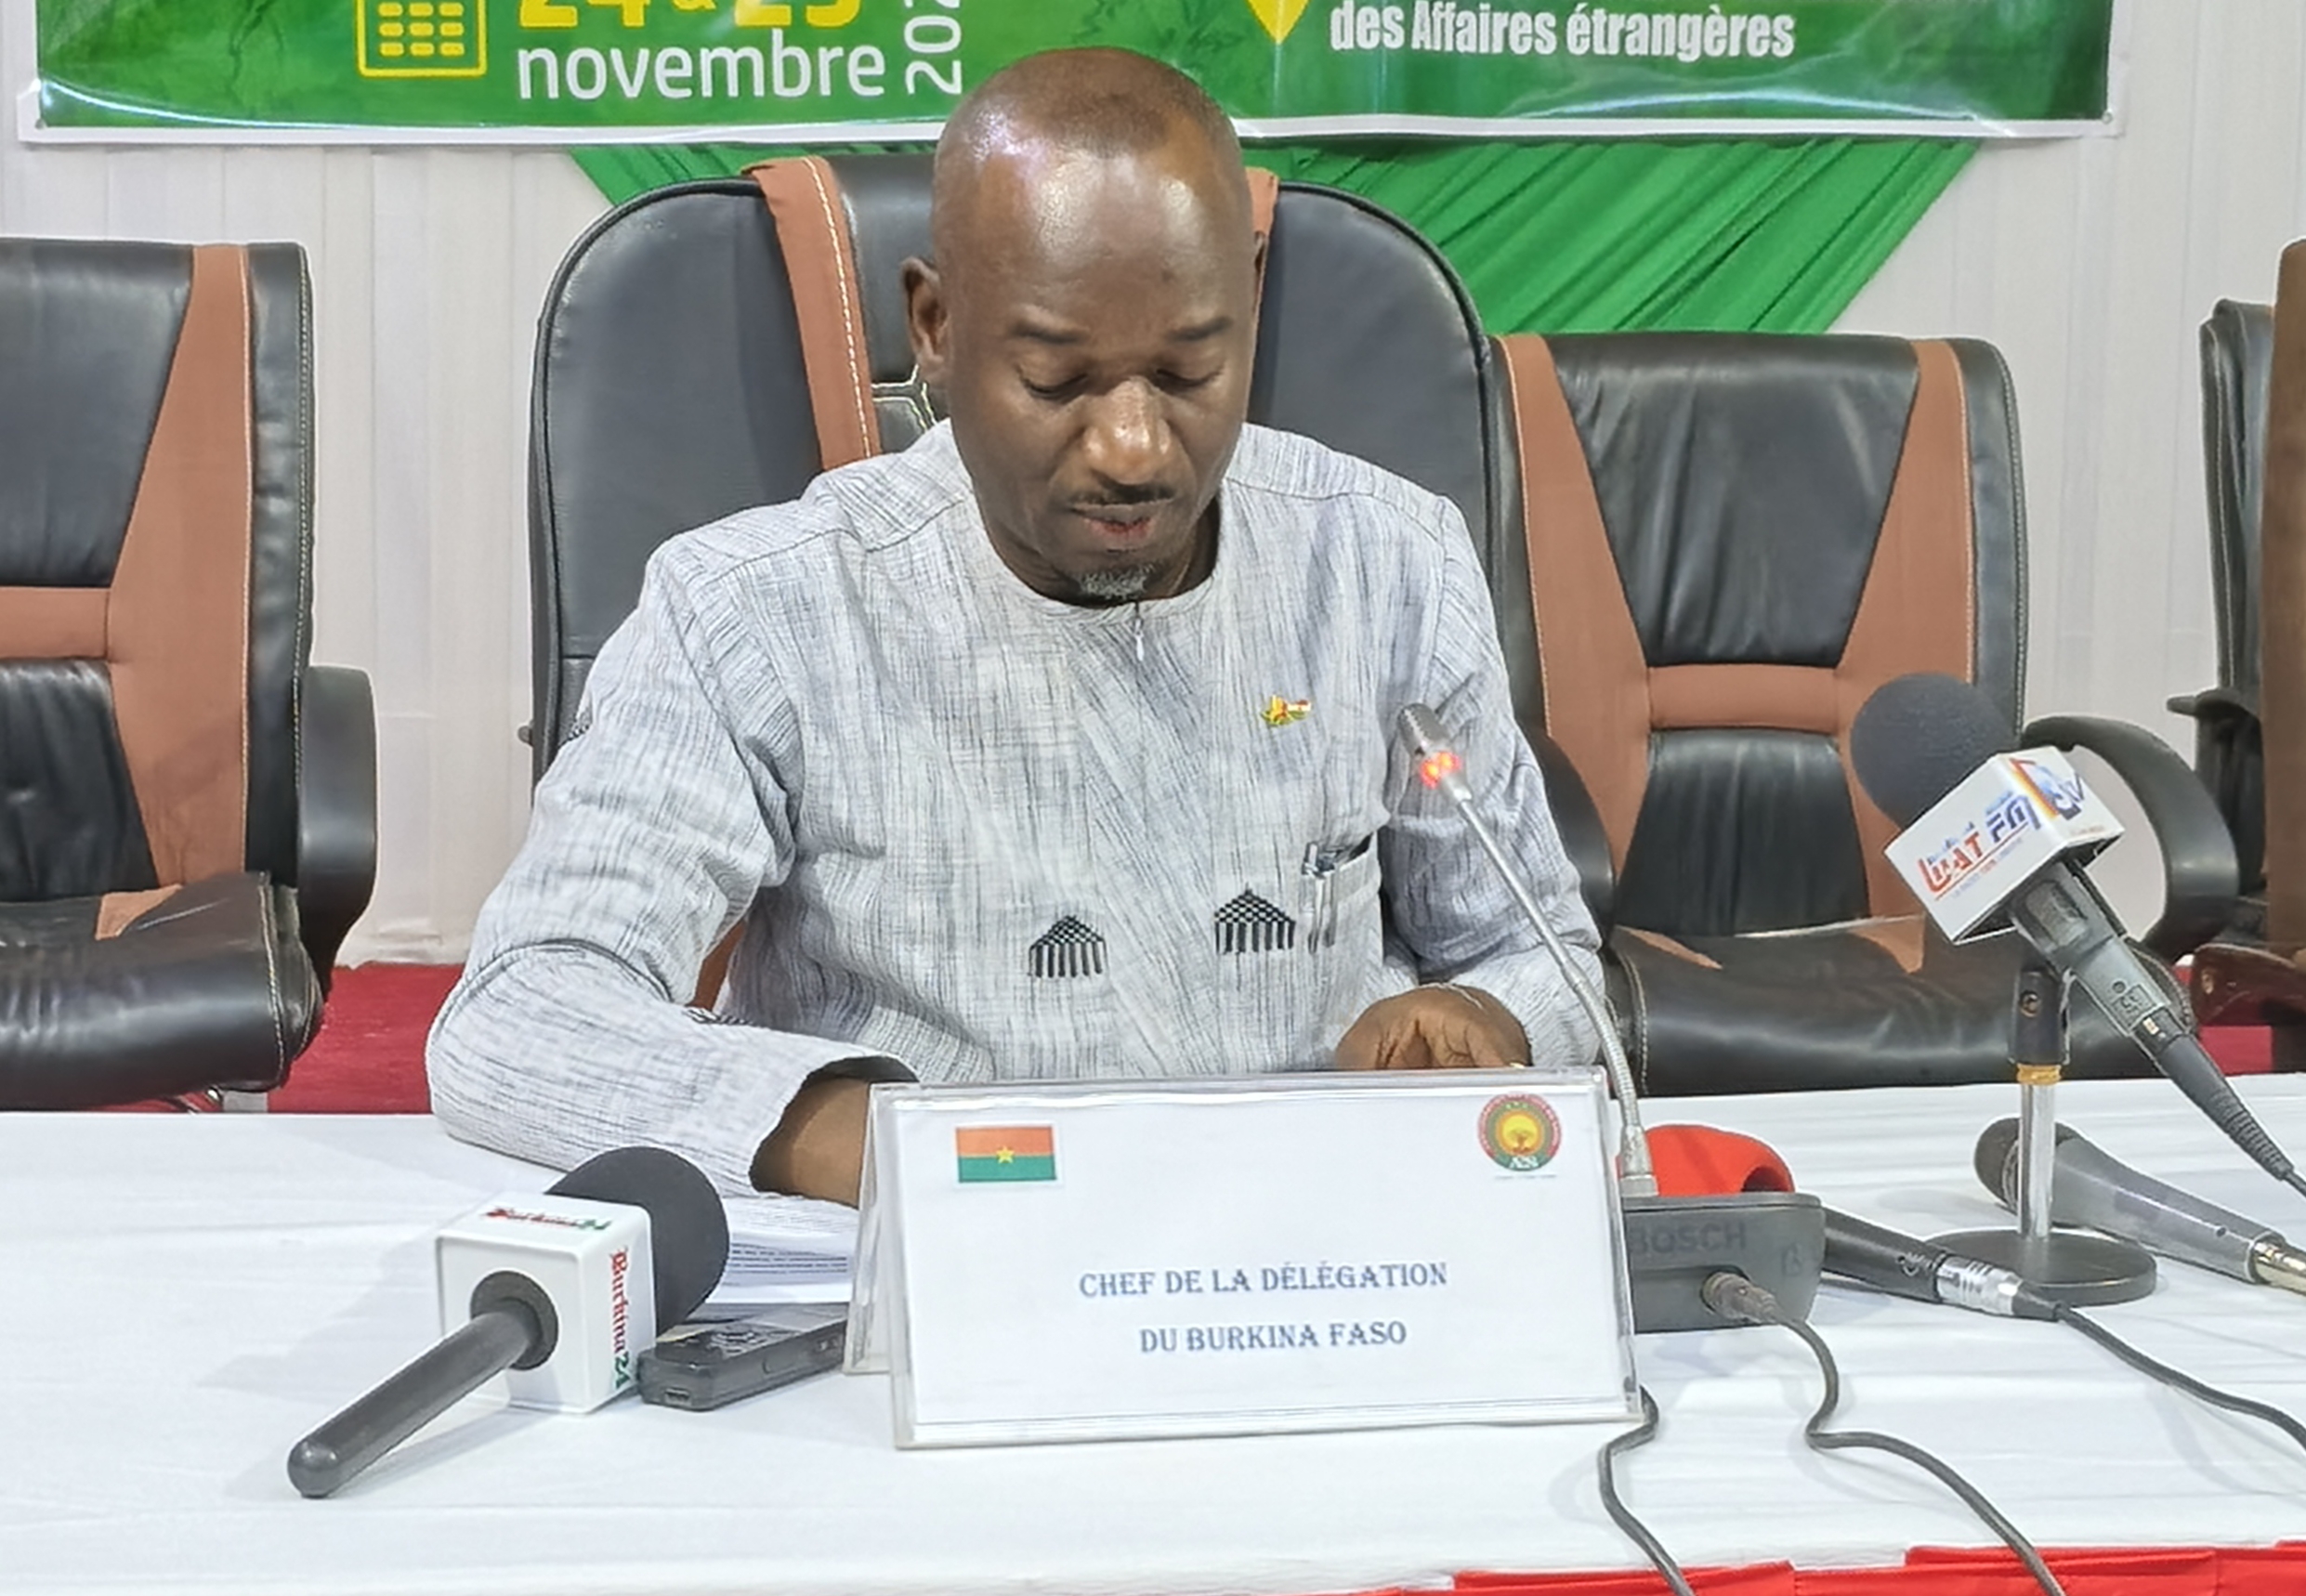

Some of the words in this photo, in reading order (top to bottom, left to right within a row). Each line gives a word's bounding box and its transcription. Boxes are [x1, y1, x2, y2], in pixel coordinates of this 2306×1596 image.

[904, 0, 962, 95] 20
[1330, 0, 1405, 50] des
[1410, 0, 1557, 55] Affaires
[1566, 3, 1794, 62] étrangères
[518, 28, 885, 99] novembre
[1079, 1272, 1155, 1298] CHEF
[1165, 1270, 1204, 1294] DE
[1212, 1268, 1251, 1292] LA
[1261, 1261, 1448, 1291] DÉLÉGATION
[1140, 1328, 1178, 1353] DU
[1186, 1324, 1320, 1352] BURKINA
[1330, 1321, 1408, 1346] FASO
